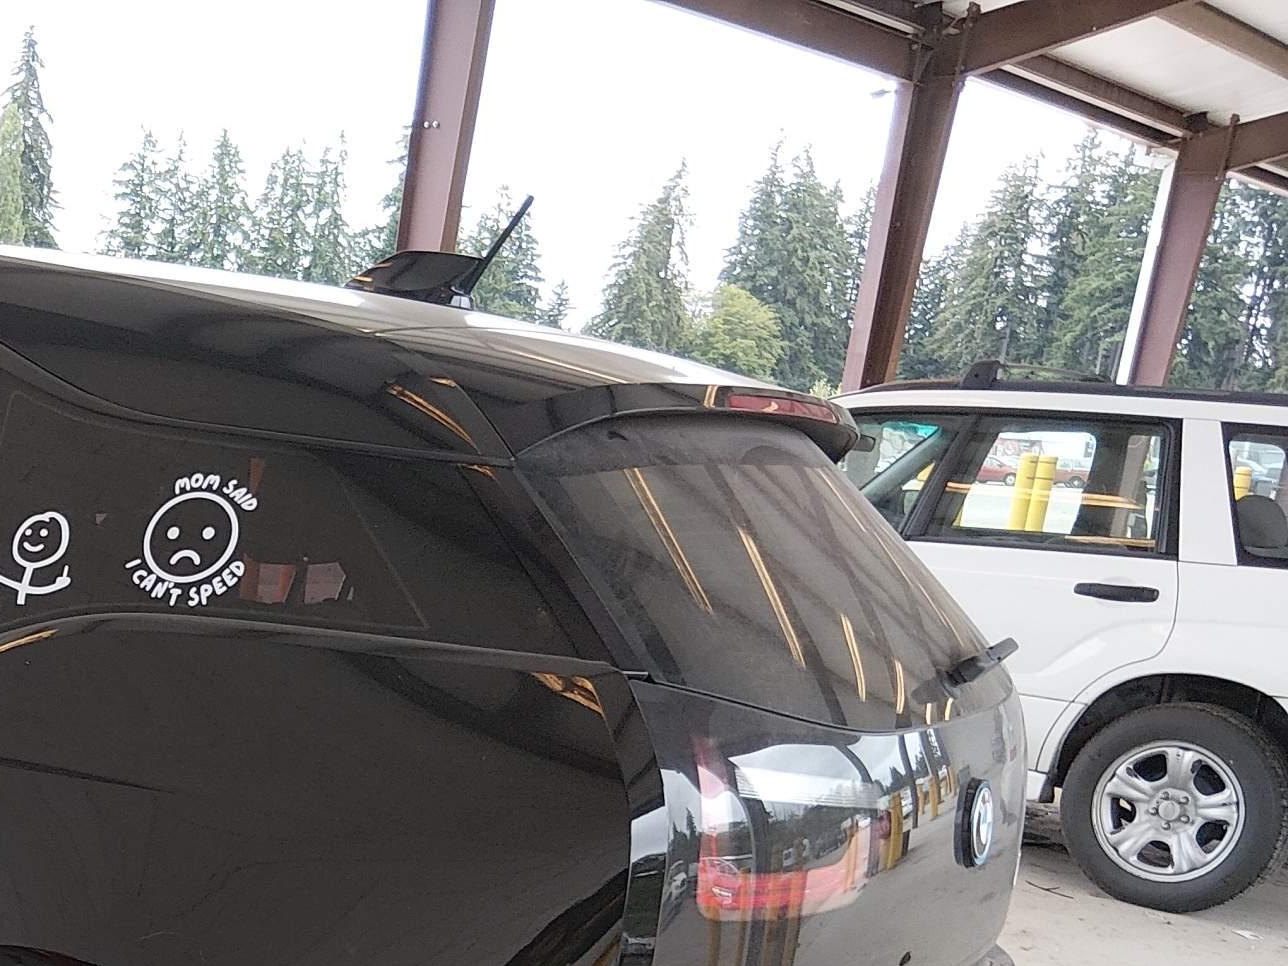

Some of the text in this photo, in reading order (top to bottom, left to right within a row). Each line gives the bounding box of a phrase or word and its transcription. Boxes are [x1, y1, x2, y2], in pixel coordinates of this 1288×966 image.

[174, 472, 258, 511] MOM SAID
[125, 558, 245, 607] I CAN'T SPEED
